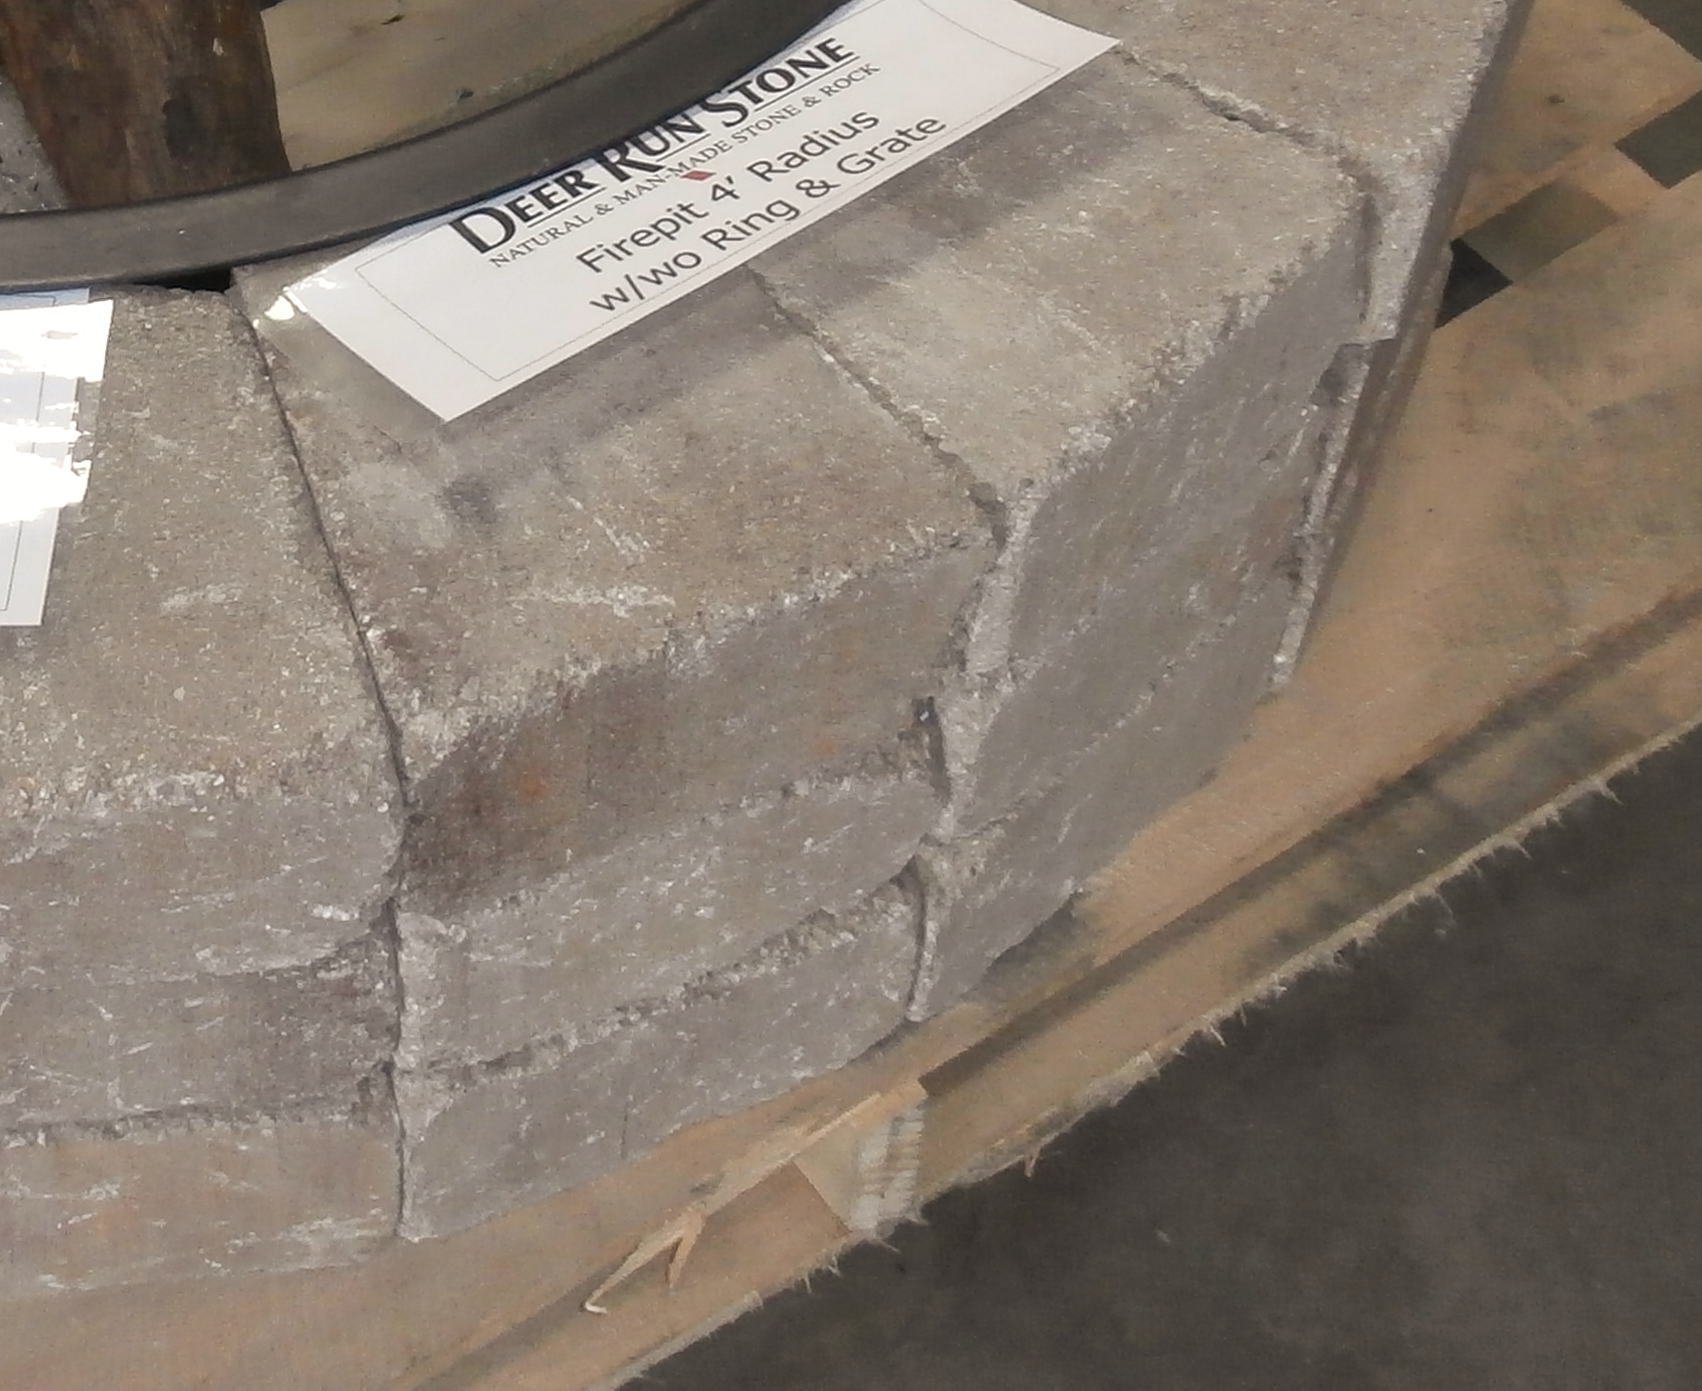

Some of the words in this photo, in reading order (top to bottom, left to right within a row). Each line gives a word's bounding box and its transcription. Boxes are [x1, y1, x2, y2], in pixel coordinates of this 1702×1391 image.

[449, 169, 600, 253] DEER
[596, 112, 706, 183] RUN
[699, 38, 854, 127] STONE
[489, 214, 594, 268] NATURAL
[594, 202, 614, 216] &
[612, 140, 733, 205] MAN-MADE
[731, 104, 802, 144] STONE
[802, 95, 822, 108] &
[819, 63, 881, 97] ROCK
[576, 203, 709, 273] Firepit
[711, 175, 740, 201] 4'
[746, 112, 880, 182] Radius
[589, 251, 702, 312] w/wo
[700, 199, 800, 251] Ring
[795, 179, 841, 198] &
[837, 118, 947, 175] Grate
